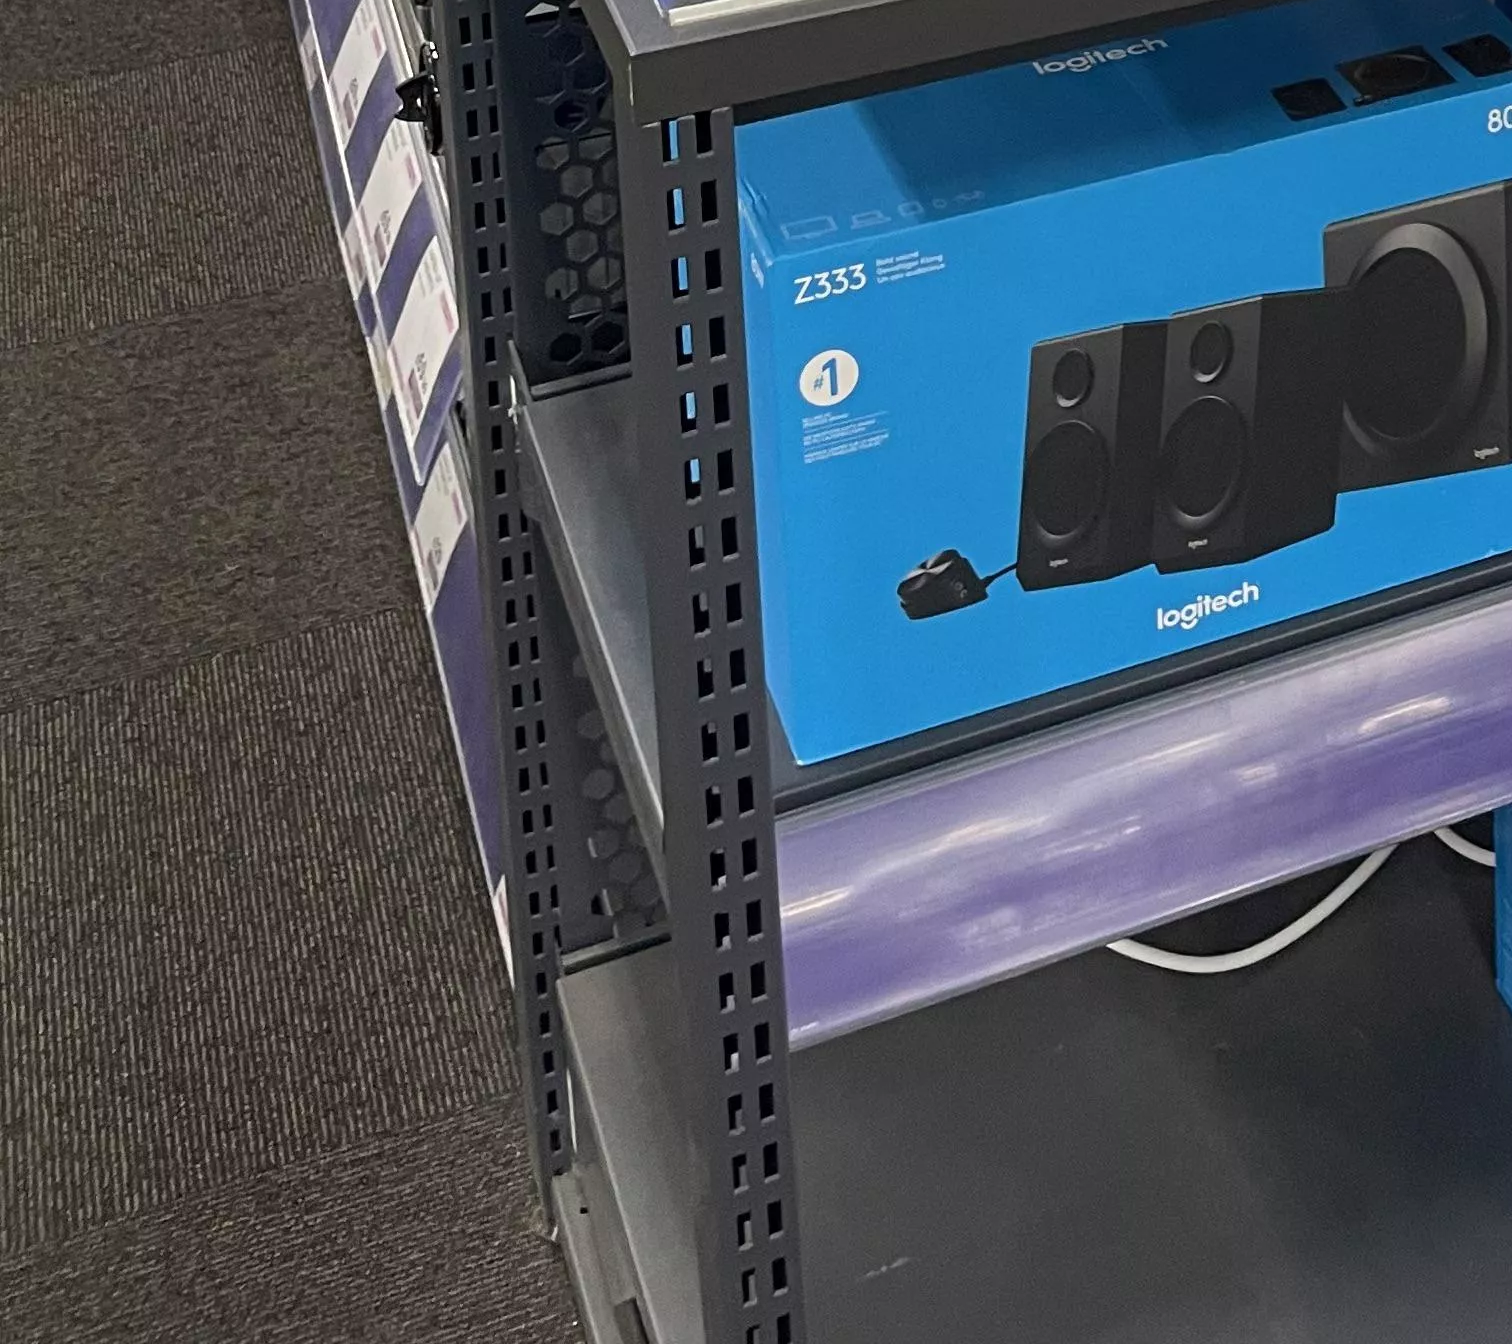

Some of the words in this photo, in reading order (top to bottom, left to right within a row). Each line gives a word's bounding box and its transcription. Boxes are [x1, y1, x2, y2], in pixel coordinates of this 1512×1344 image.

[1033, 37, 1168, 75] logitech
[794, 263, 866, 304] Z333
[1156, 582, 1259, 630] logitech
